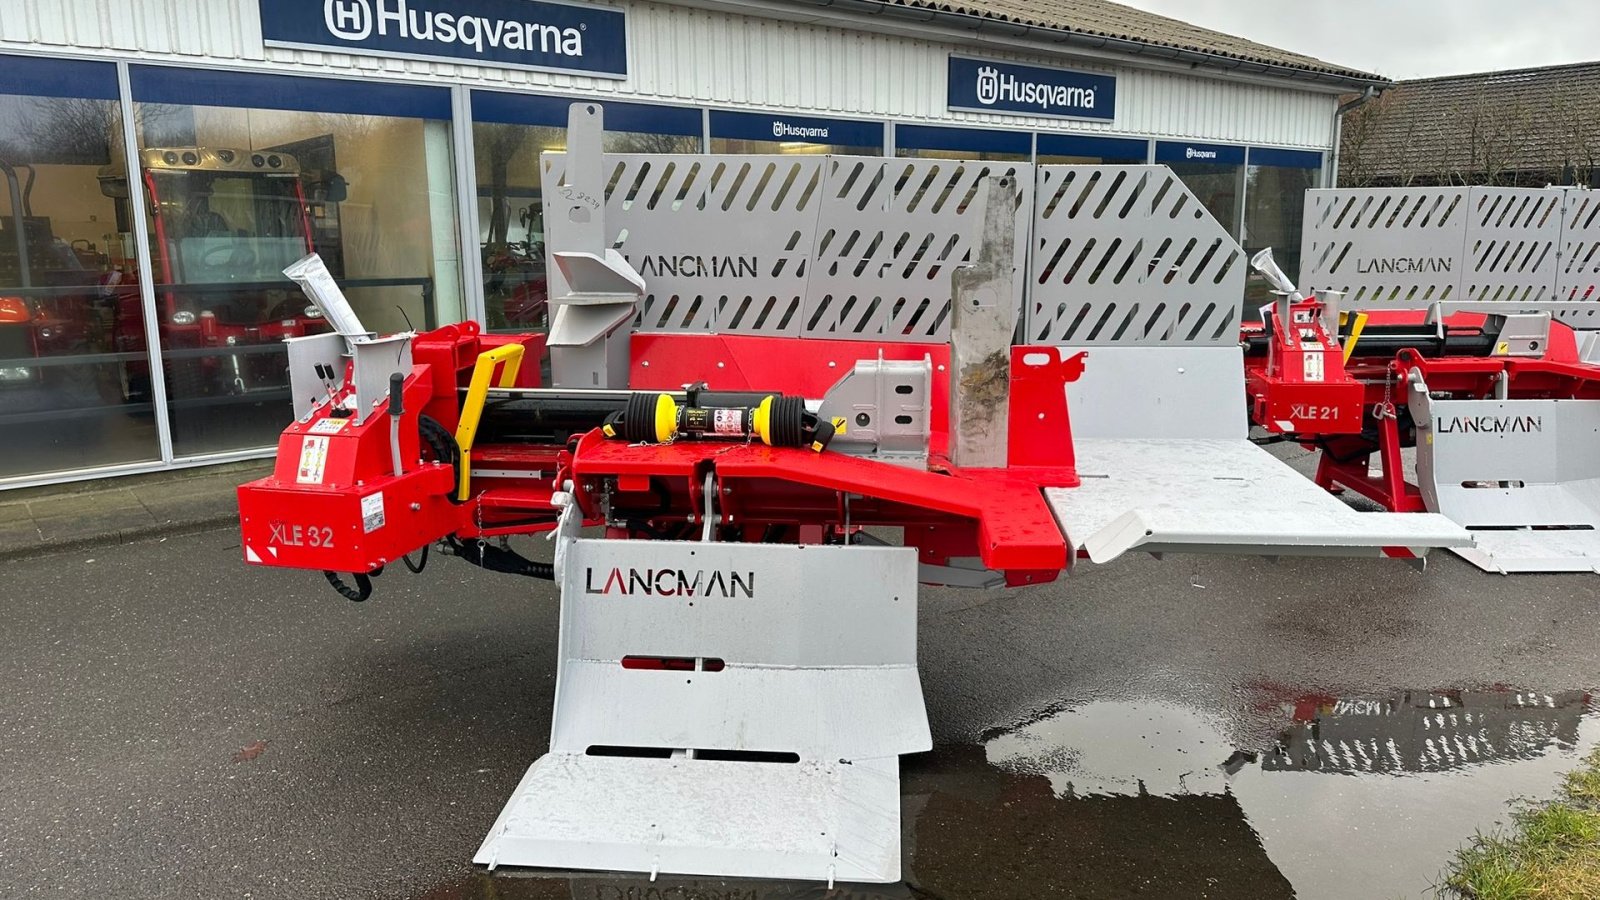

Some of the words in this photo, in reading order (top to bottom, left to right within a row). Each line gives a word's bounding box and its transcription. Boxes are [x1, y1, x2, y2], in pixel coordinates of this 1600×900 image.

[377, 0, 583, 56] Husqvarna
[999, 73, 1094, 109] Husqvarna
[783, 123, 829, 138] Husqvarna
[1357, 257, 1452, 273] LANCMAN
[1289, 405, 1317, 420] XLE
[1320, 406, 1339, 420] 21
[1437, 416, 1542, 433] LANCMAN
[269, 523, 304, 546] XLE
[308, 526, 335, 548] 32
[585, 567, 755, 598] LANCMAN
